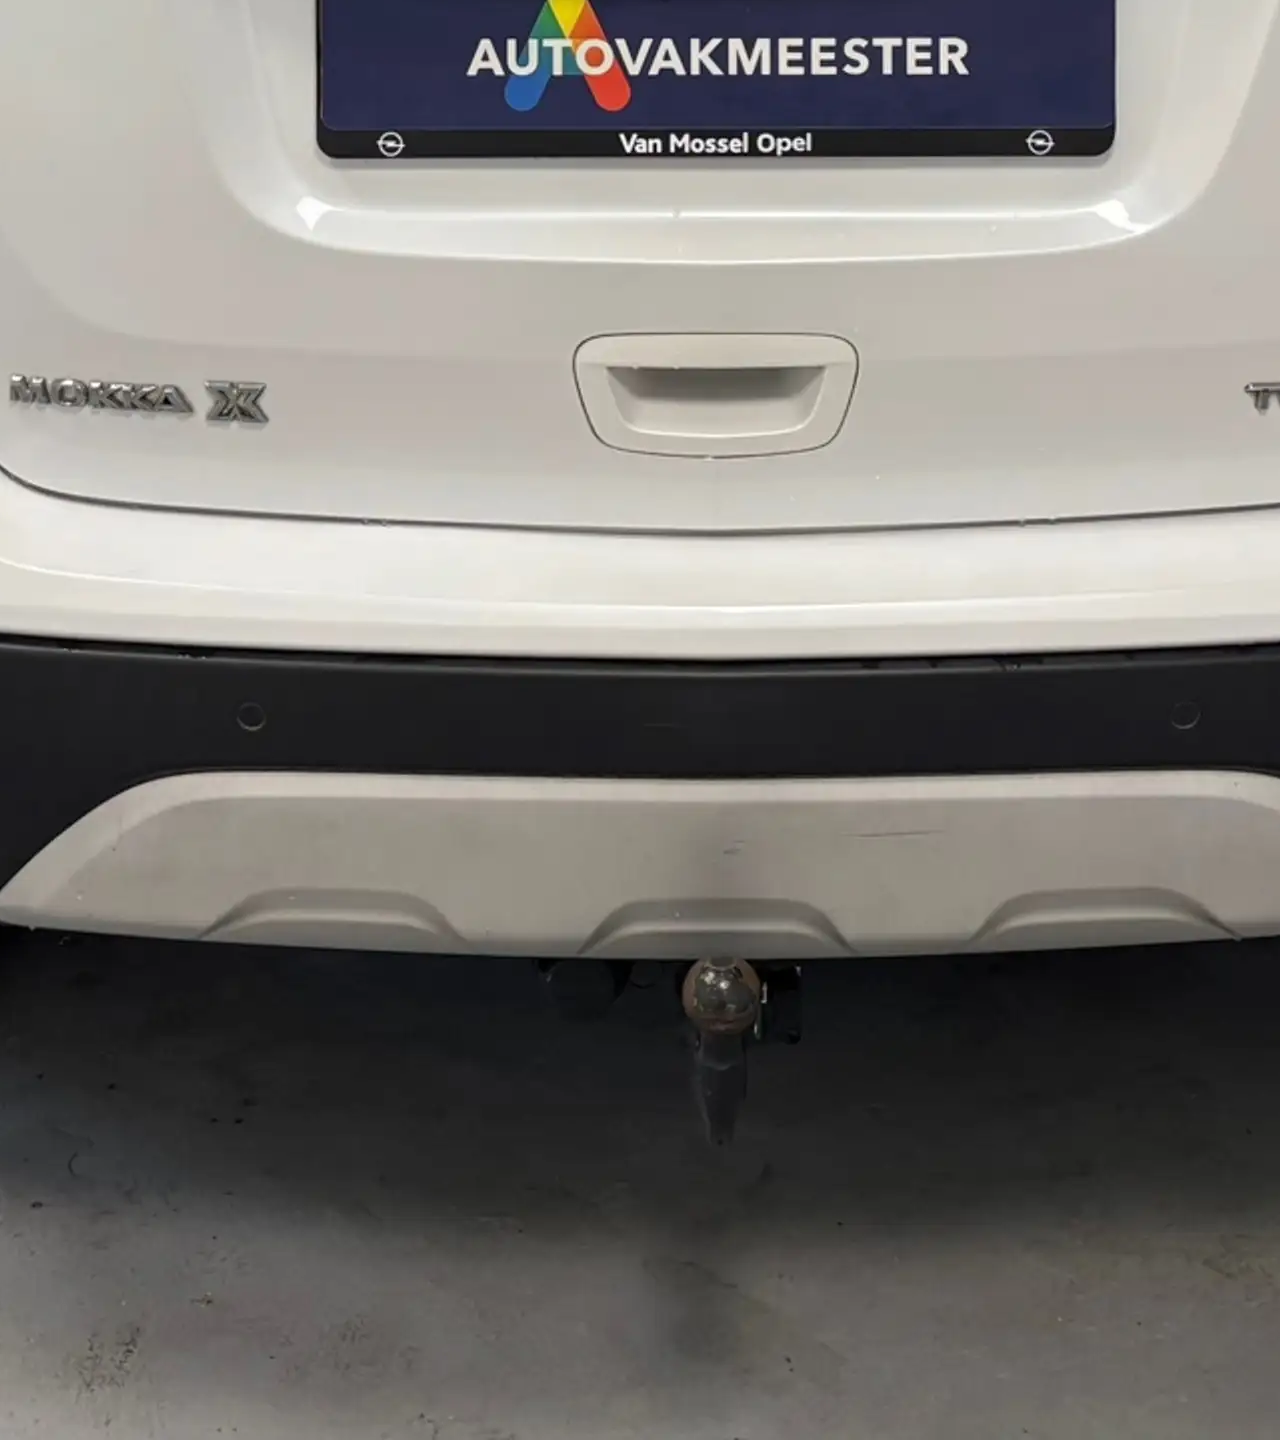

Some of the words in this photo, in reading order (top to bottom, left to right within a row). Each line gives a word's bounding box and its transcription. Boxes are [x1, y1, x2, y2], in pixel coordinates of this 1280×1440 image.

[466, 37, 970, 76] AUTOVAKMEESTER
[619, 133, 662, 153] Van
[669, 131, 749, 154] Mossel
[756, 132, 812, 156] Opel
[9, 374, 194, 414] MOKKA
[204, 380, 270, 423] X
